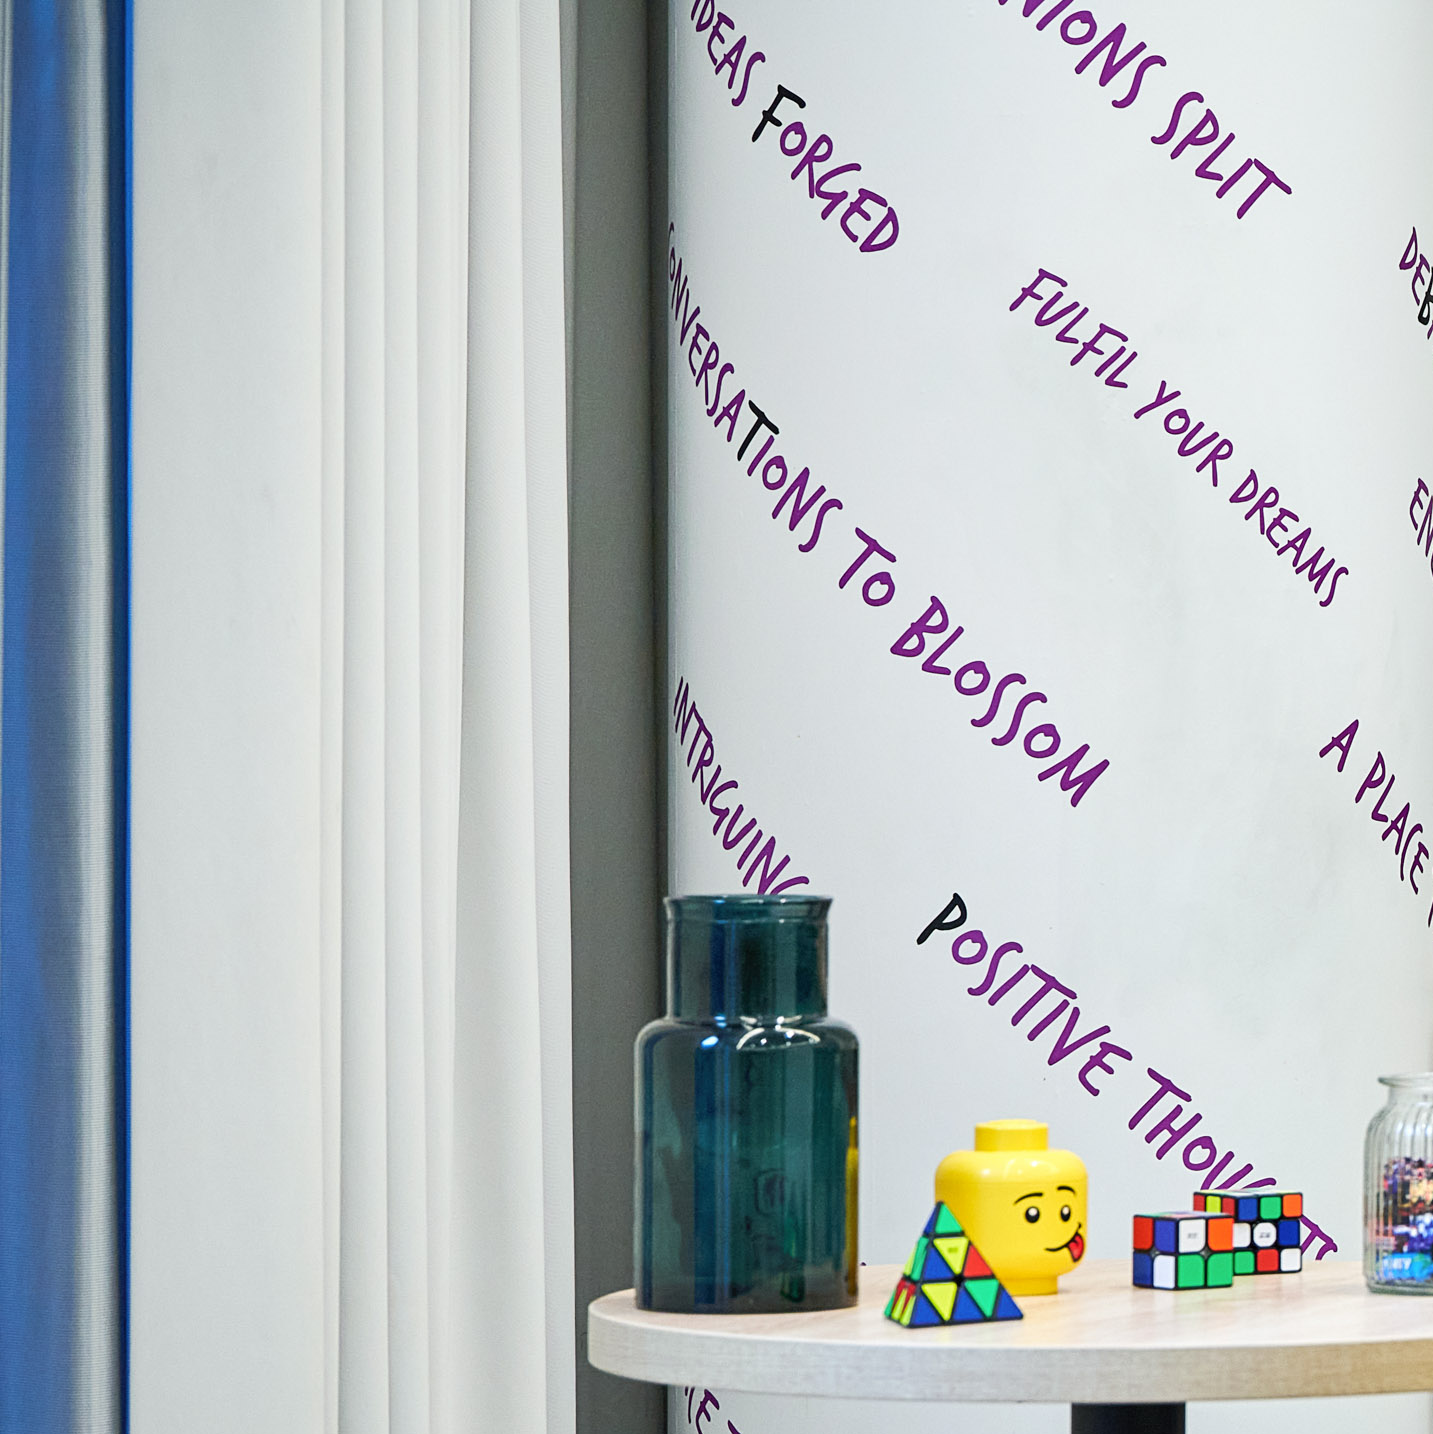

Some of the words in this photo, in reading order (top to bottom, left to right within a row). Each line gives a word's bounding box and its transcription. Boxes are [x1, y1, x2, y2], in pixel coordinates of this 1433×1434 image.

[751, 84, 900, 253] FORGED
[1022, 0, 1167, 109] IONS
[1150, 91, 1293, 220] SPLIT
[668, 222, 844, 553] CONVERSATIONS
[838, 526, 897, 607] TO
[889, 595, 1110, 808] BLOSSOM
[1008, 267, 1138, 389] FULFIL
[1133, 380, 1235, 488] YOUR
[1228, 468, 1350, 607] DREAMS
[1318, 719, 1360, 773] A
[1354, 750, 1430, 895] PLACE
[916, 892, 1133, 1097] POSITIVE
